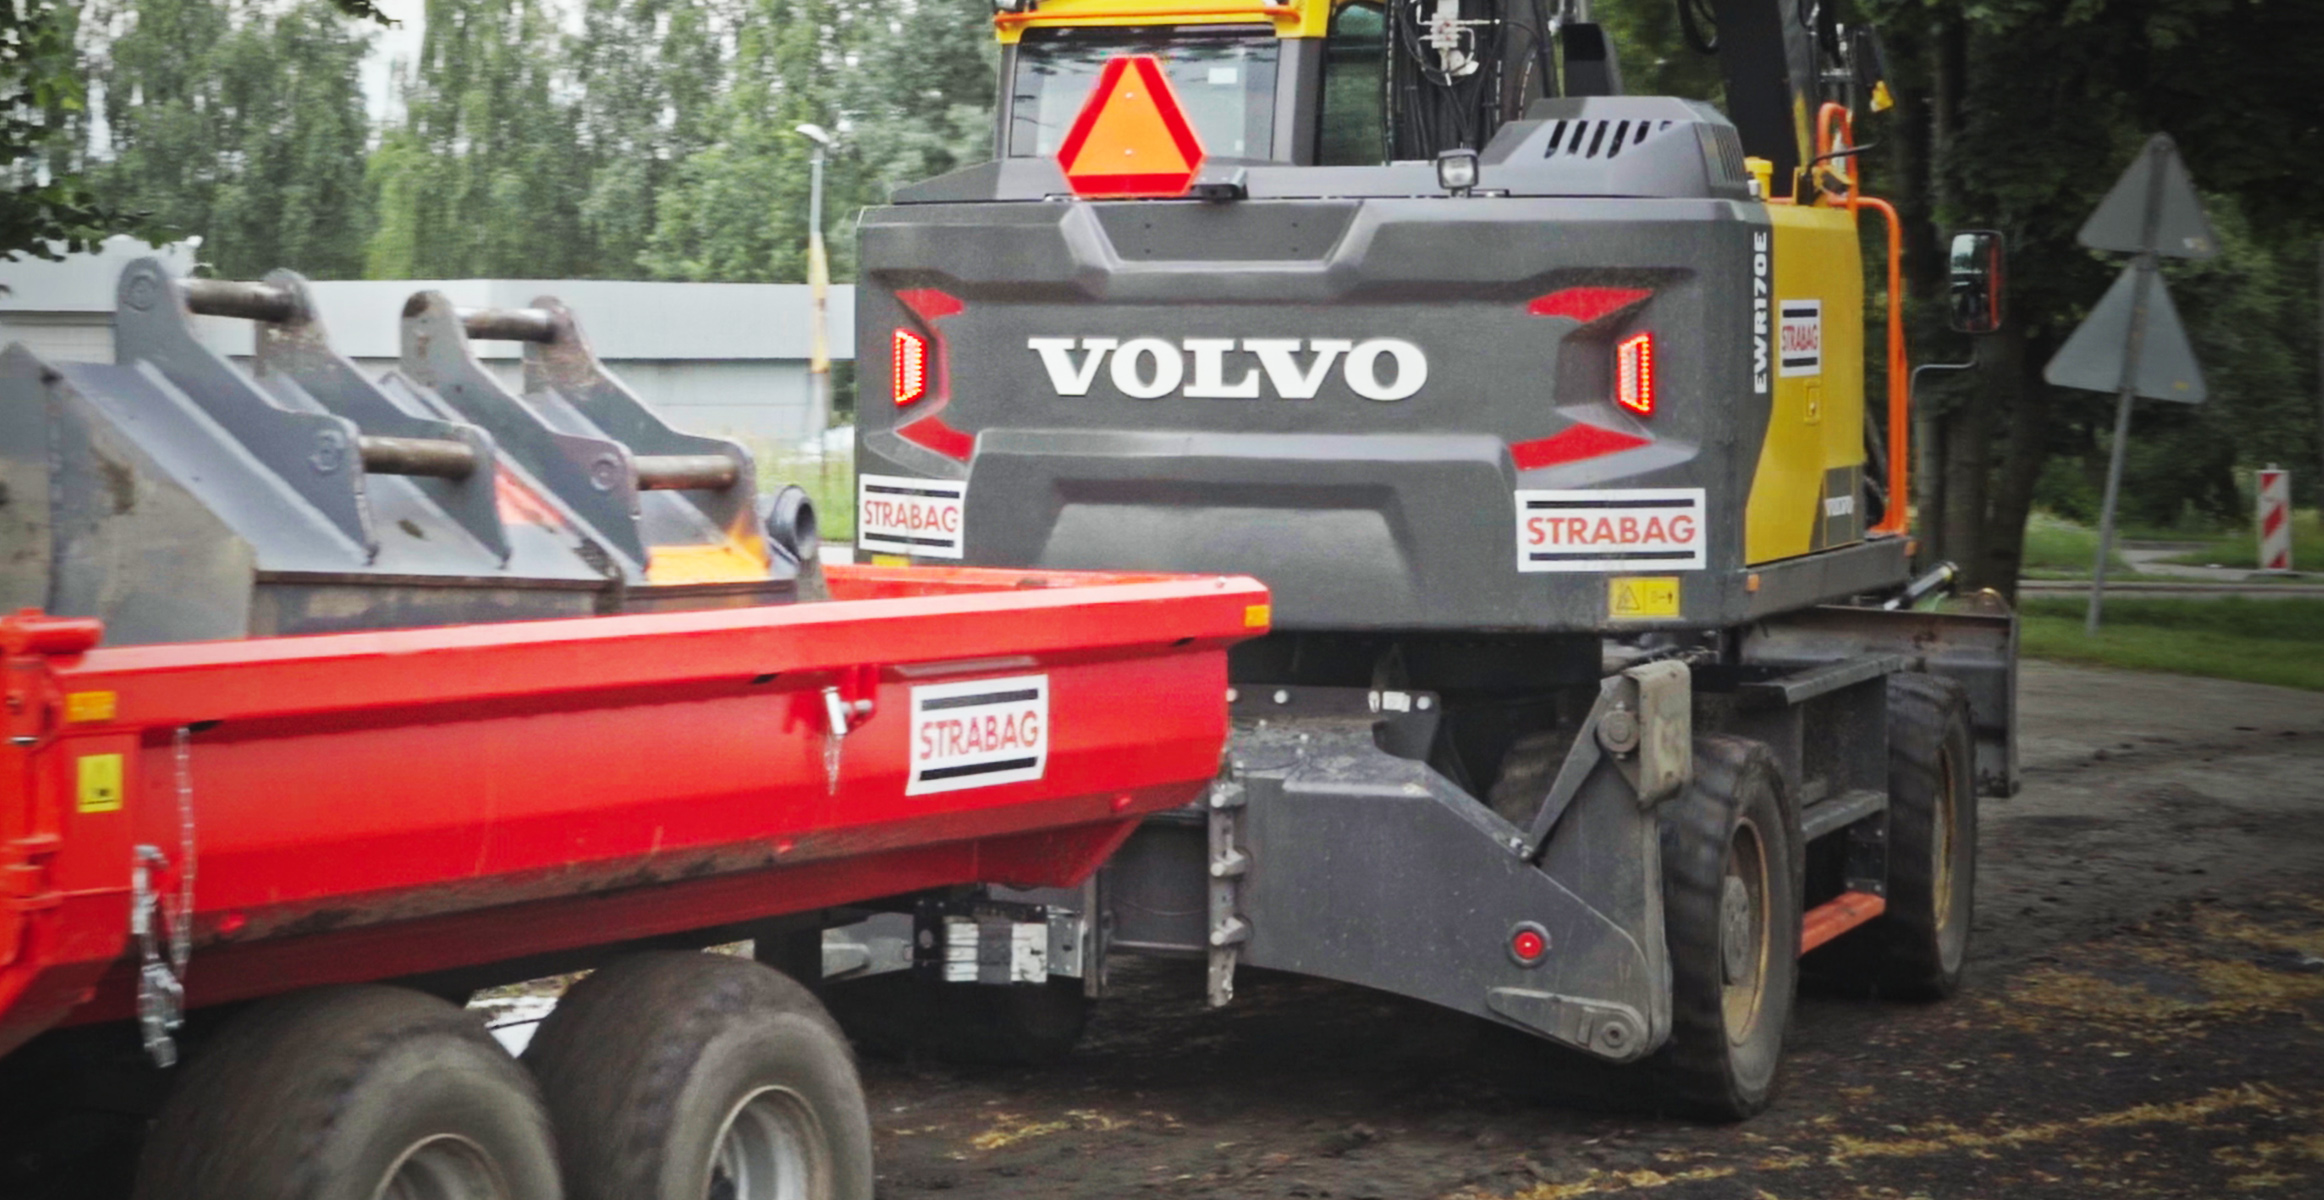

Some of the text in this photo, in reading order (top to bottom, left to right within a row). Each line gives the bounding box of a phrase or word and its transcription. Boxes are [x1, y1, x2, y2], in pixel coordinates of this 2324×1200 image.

[1754, 232, 1767, 393] EWR170E
[1028, 337, 1428, 401] VOLVO
[864, 500, 958, 533] STRABAG
[1527, 515, 1696, 545] STRABAG
[920, 710, 1038, 760] STRABAG
